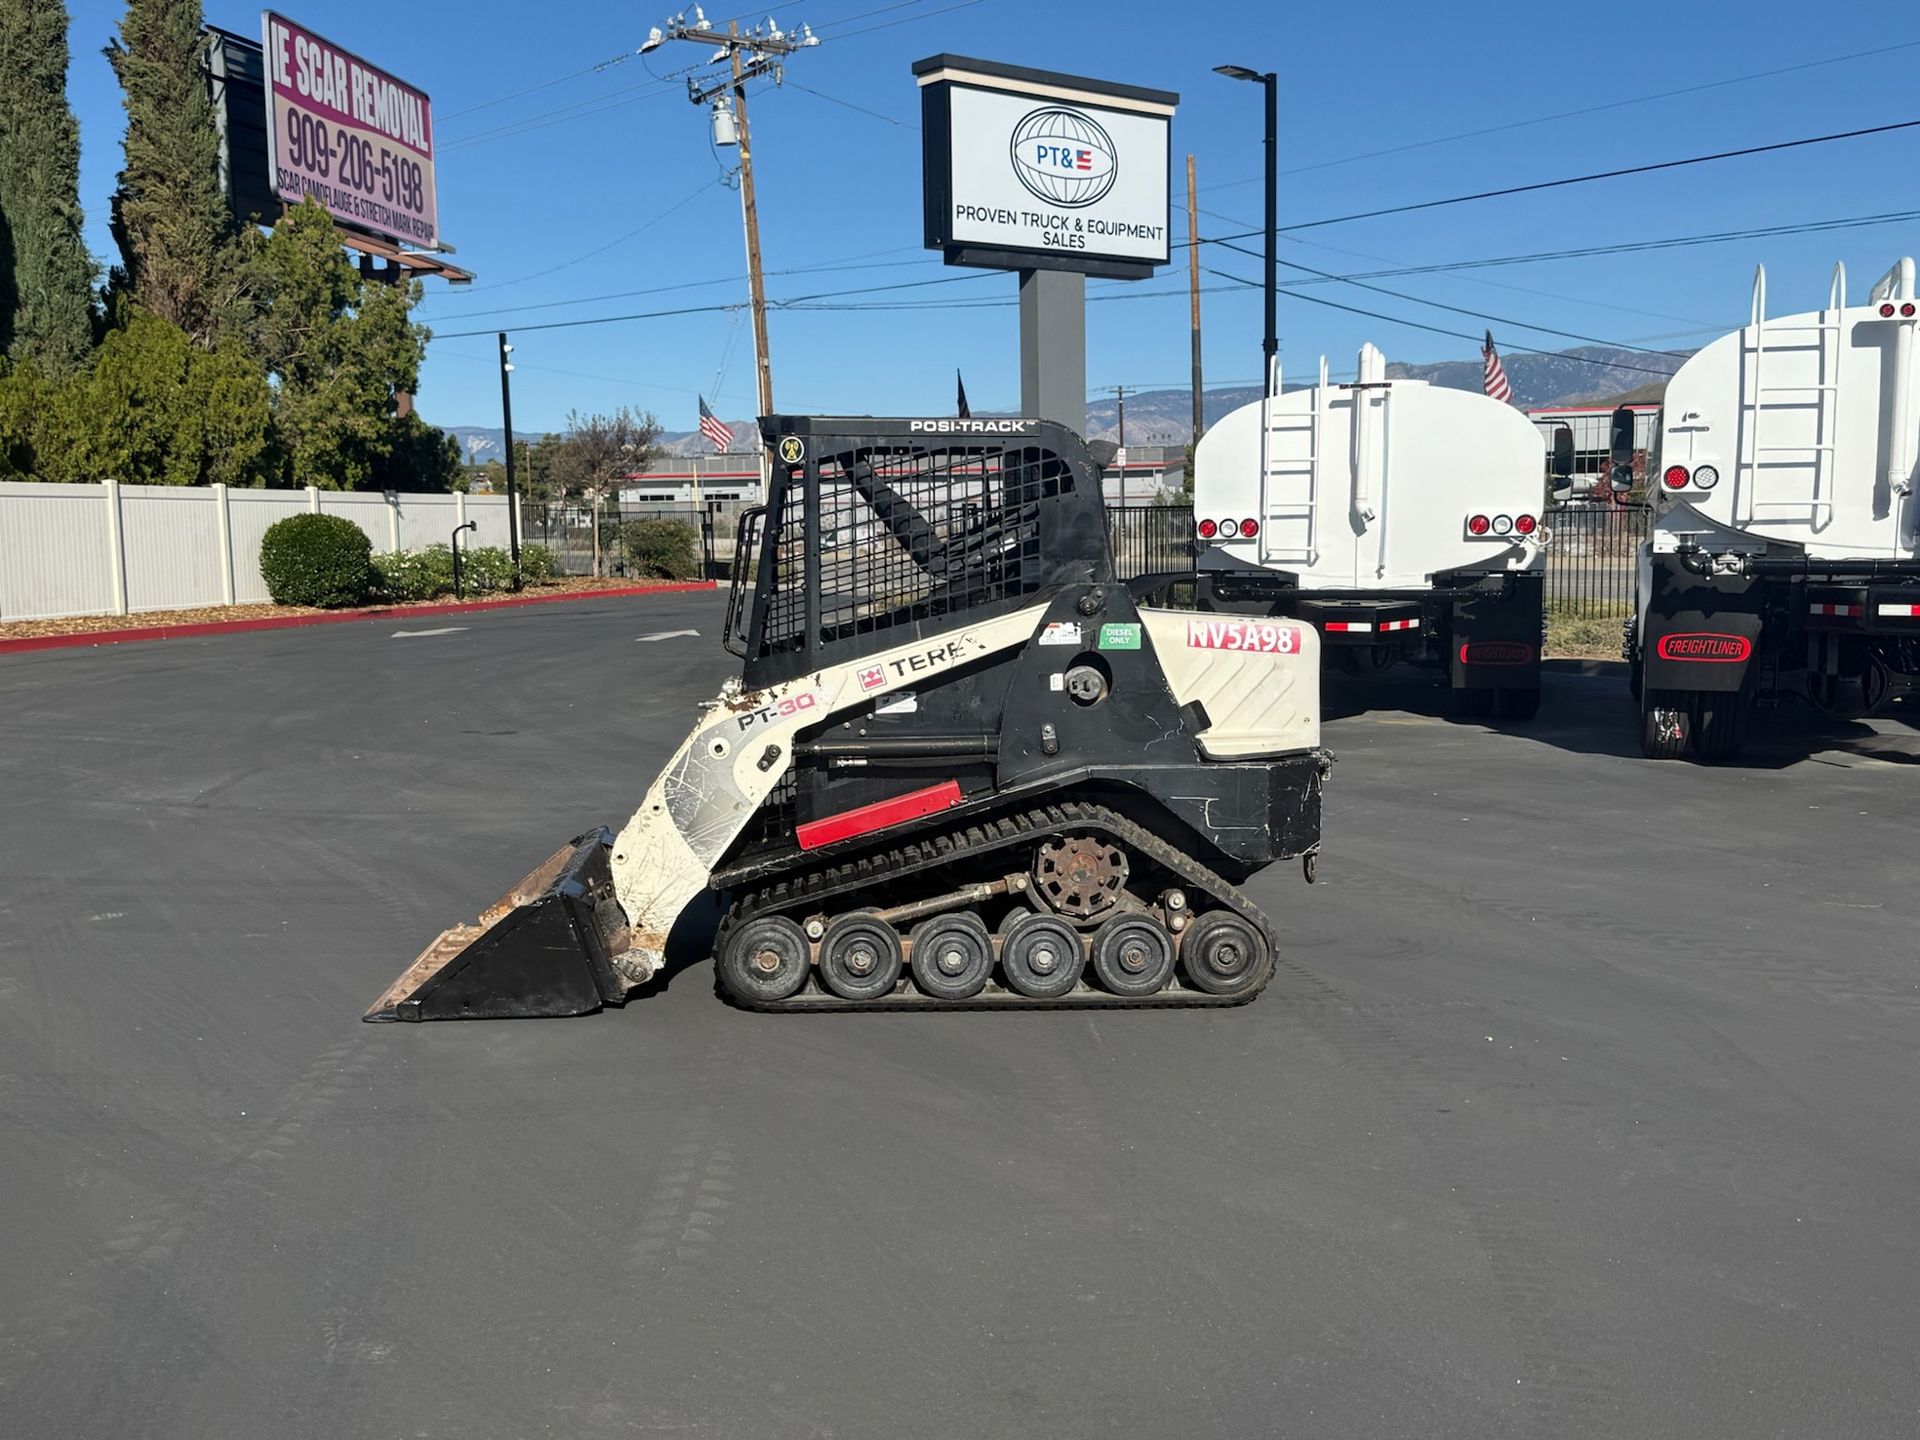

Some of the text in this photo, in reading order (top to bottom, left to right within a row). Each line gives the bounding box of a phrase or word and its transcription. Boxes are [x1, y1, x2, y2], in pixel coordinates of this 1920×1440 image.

[271, 21, 429, 152] IE SCAR REMOVAL
[287, 107, 424, 215] 909-206-5198
[277, 167, 301, 195] SCAR
[354, 196, 360, 216] &
[360, 198, 391, 229] STRETCH
[392, 210, 412, 235] MARK
[956, 205, 1164, 241] PROVEN TRUCK & EQUIPMENT
[1042, 231, 1086, 249] SALES
[910, 420, 1026, 433] POSI-TRACK
[1106, 628, 1133, 636] DIESEL
[1109, 637, 1130, 645] ONLY
[1188, 621, 1294, 653] NV5A98
[1667, 639, 1743, 656] FREIGHTLINER
[888, 636, 987, 677] TERE
[737, 692, 816, 731] PT-30
